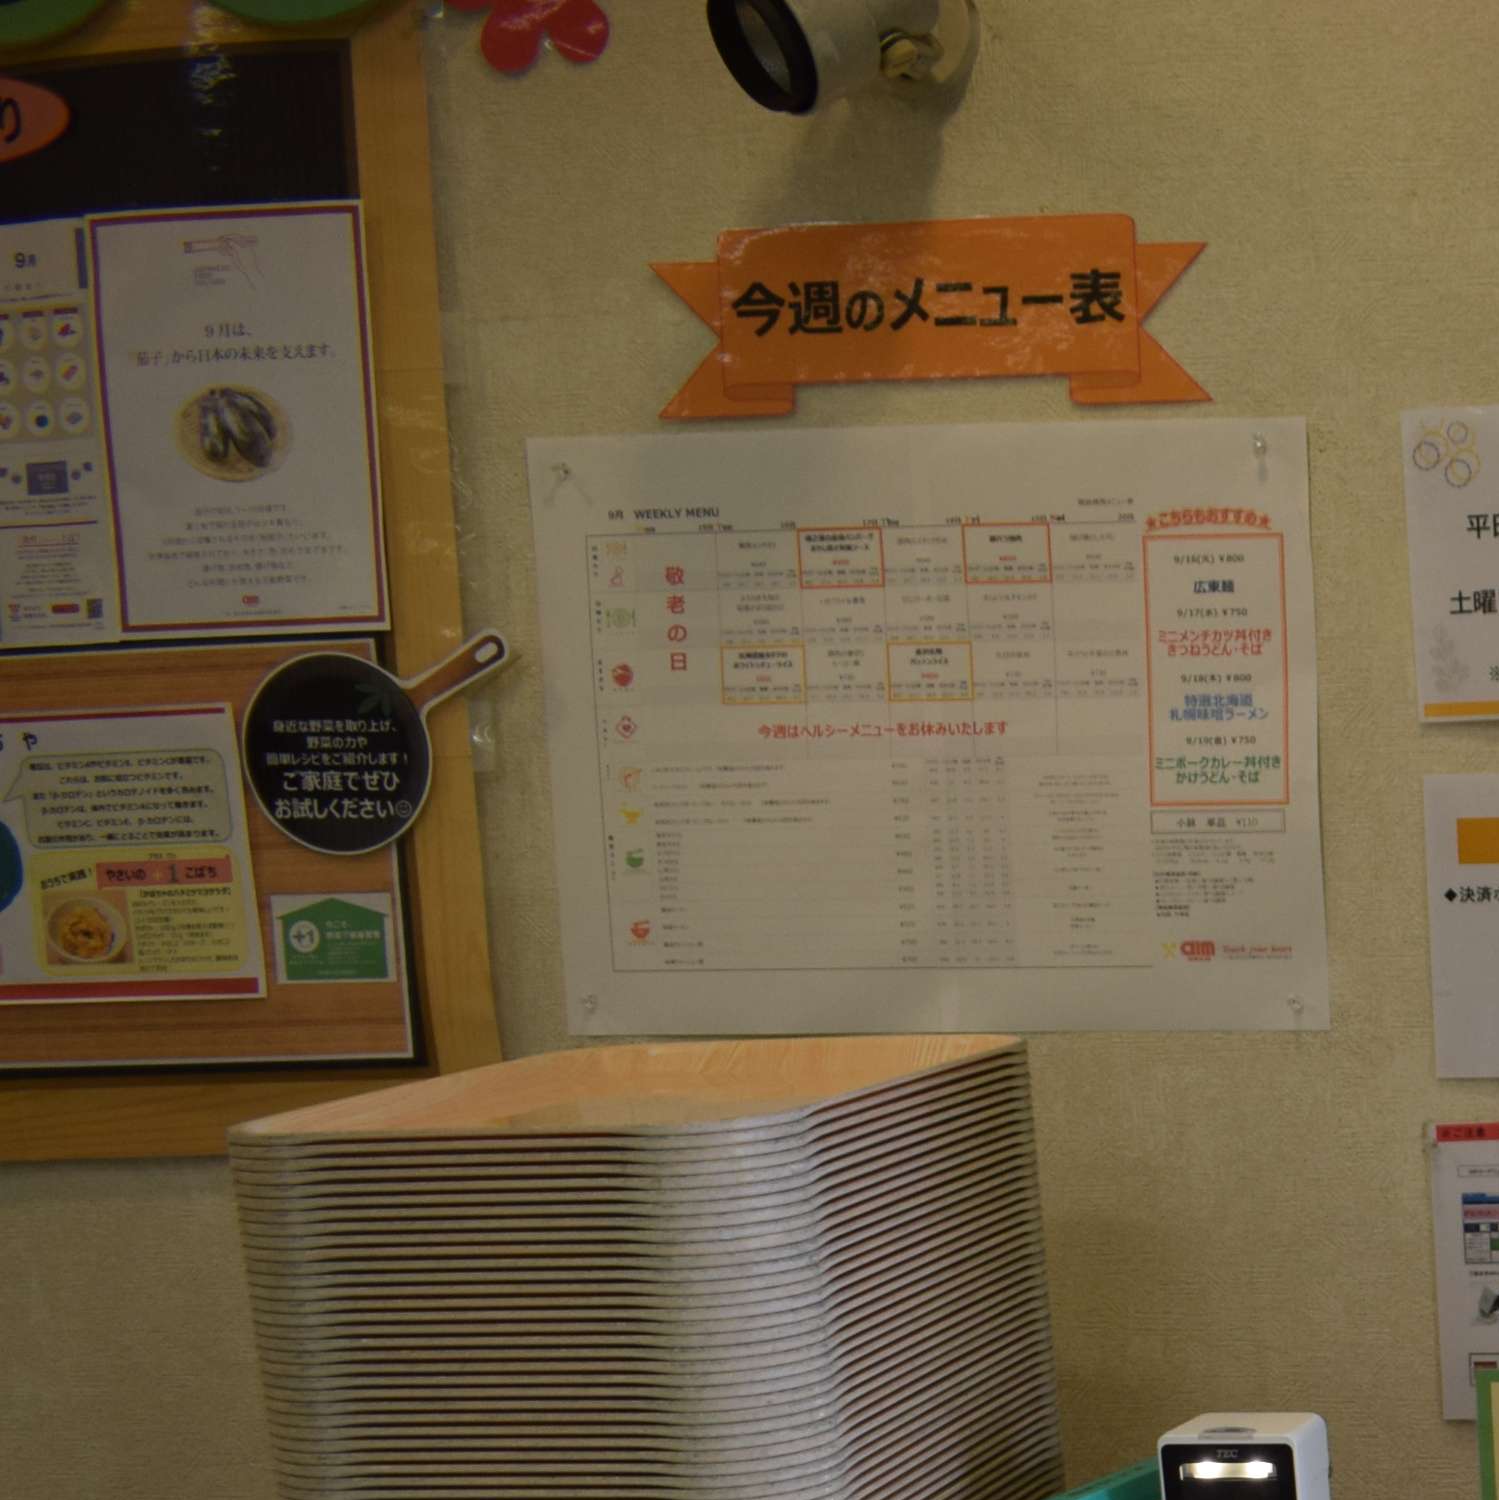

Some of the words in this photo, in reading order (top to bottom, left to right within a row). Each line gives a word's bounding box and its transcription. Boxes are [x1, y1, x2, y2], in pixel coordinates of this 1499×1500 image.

[730, 266, 1127, 339] 今週のメニュー表
[633, 507, 682, 521] WEEKLY
[684, 506, 720, 519] MENU
[664, 563, 690, 674] 敬老の日
[281, 769, 401, 793] ご家庭でぜひ
